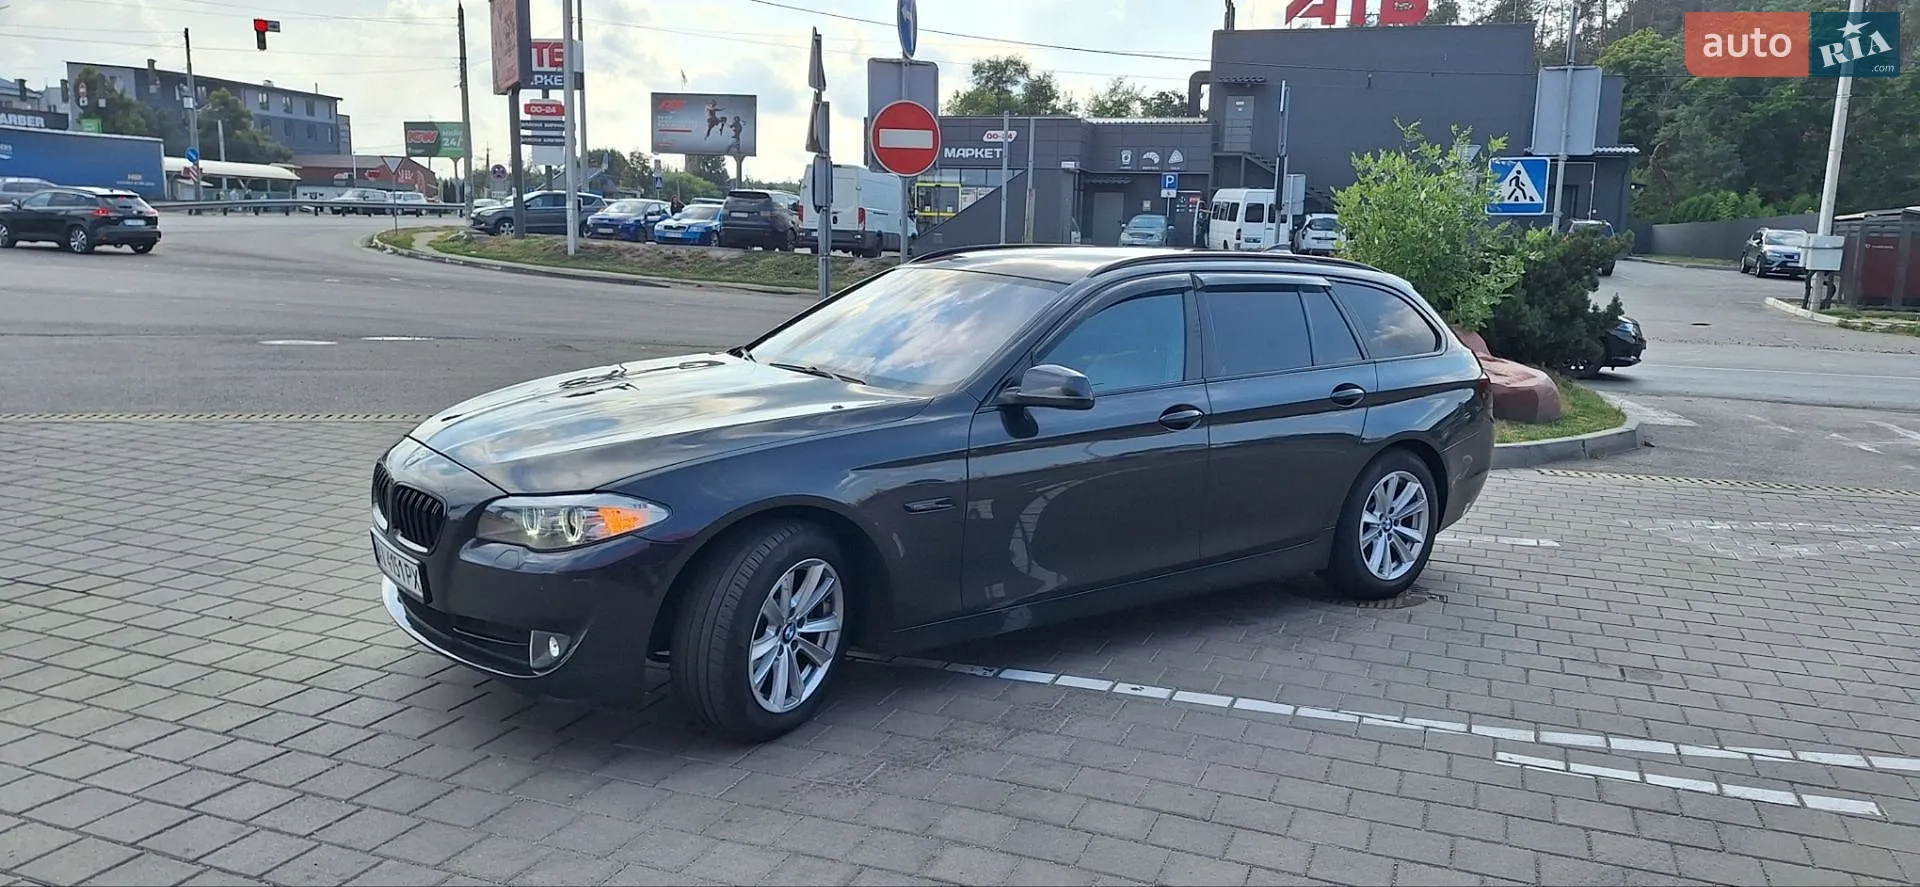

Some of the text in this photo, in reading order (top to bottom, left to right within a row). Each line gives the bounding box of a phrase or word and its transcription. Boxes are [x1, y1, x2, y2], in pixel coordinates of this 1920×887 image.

[530, 105, 557, 114] 00-24
[0, 112, 45, 127] ARBER
[943, 147, 1004, 159] МАРКЕТ
